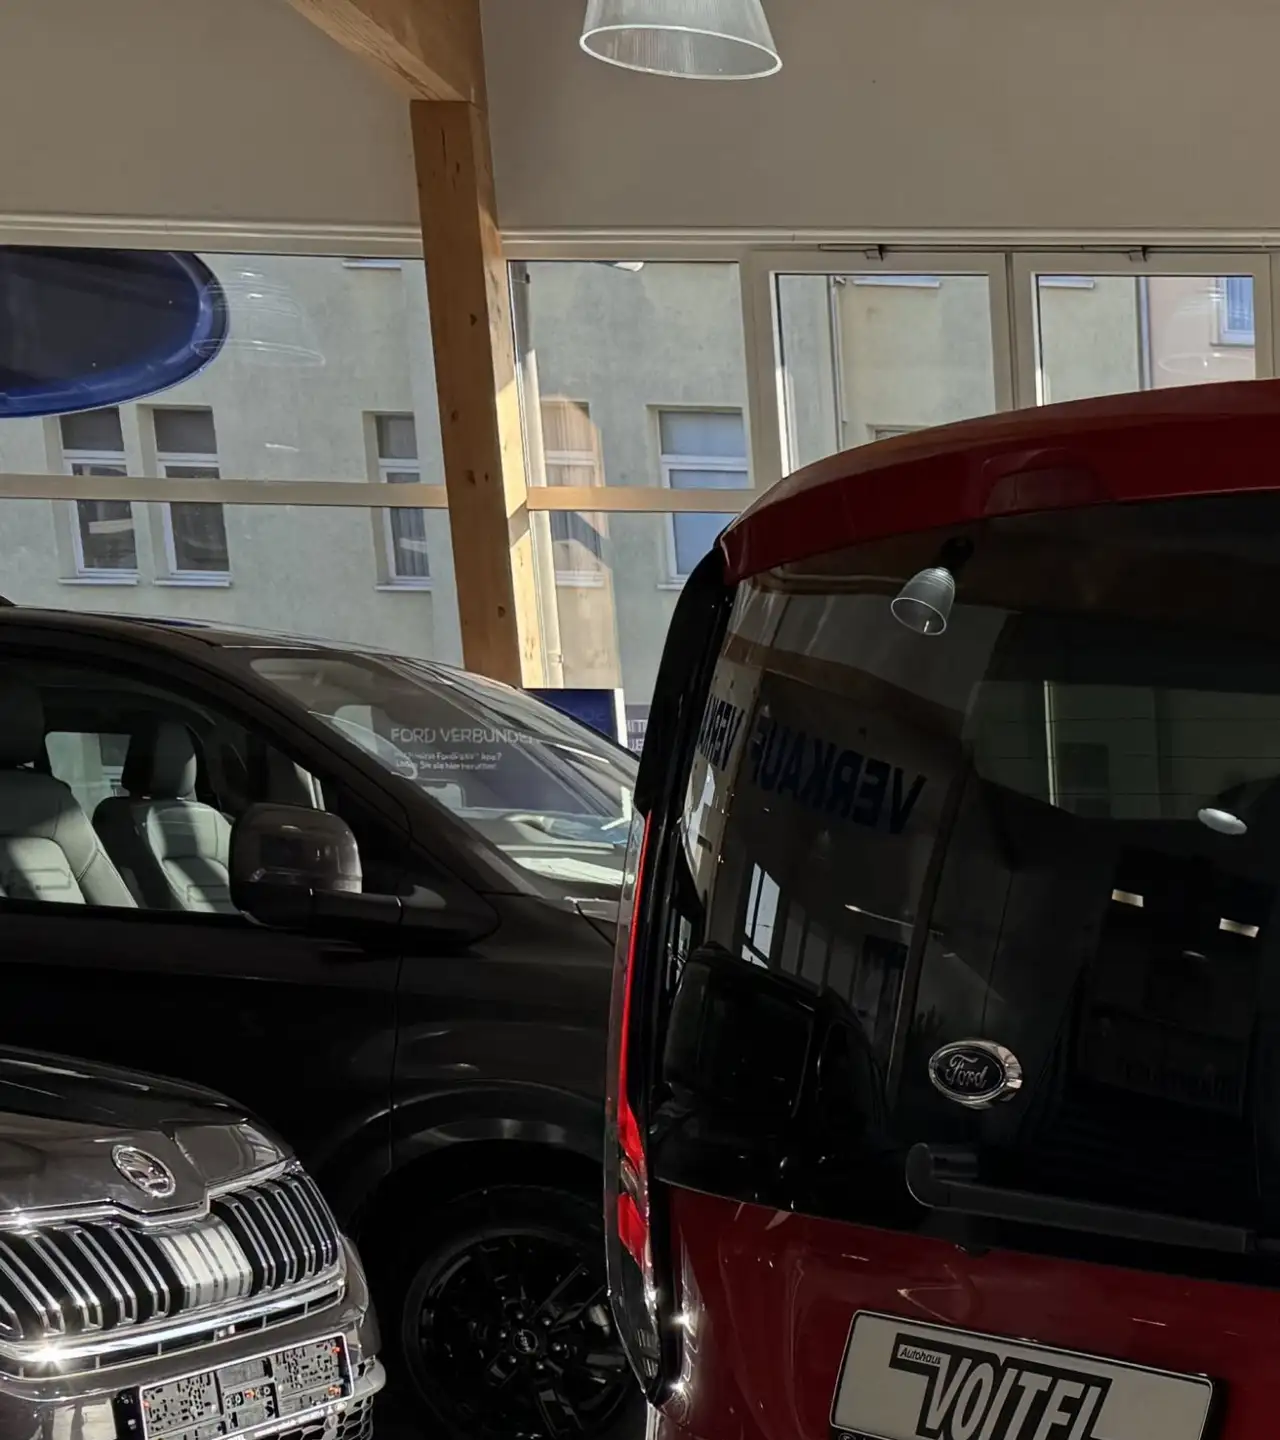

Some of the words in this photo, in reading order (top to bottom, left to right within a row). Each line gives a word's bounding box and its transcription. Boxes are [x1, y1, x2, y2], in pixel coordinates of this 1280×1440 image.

[390, 727, 436, 744] FORD
[944, 1053, 989, 1089] Ford
[900, 1346, 942, 1367] Autohaus
